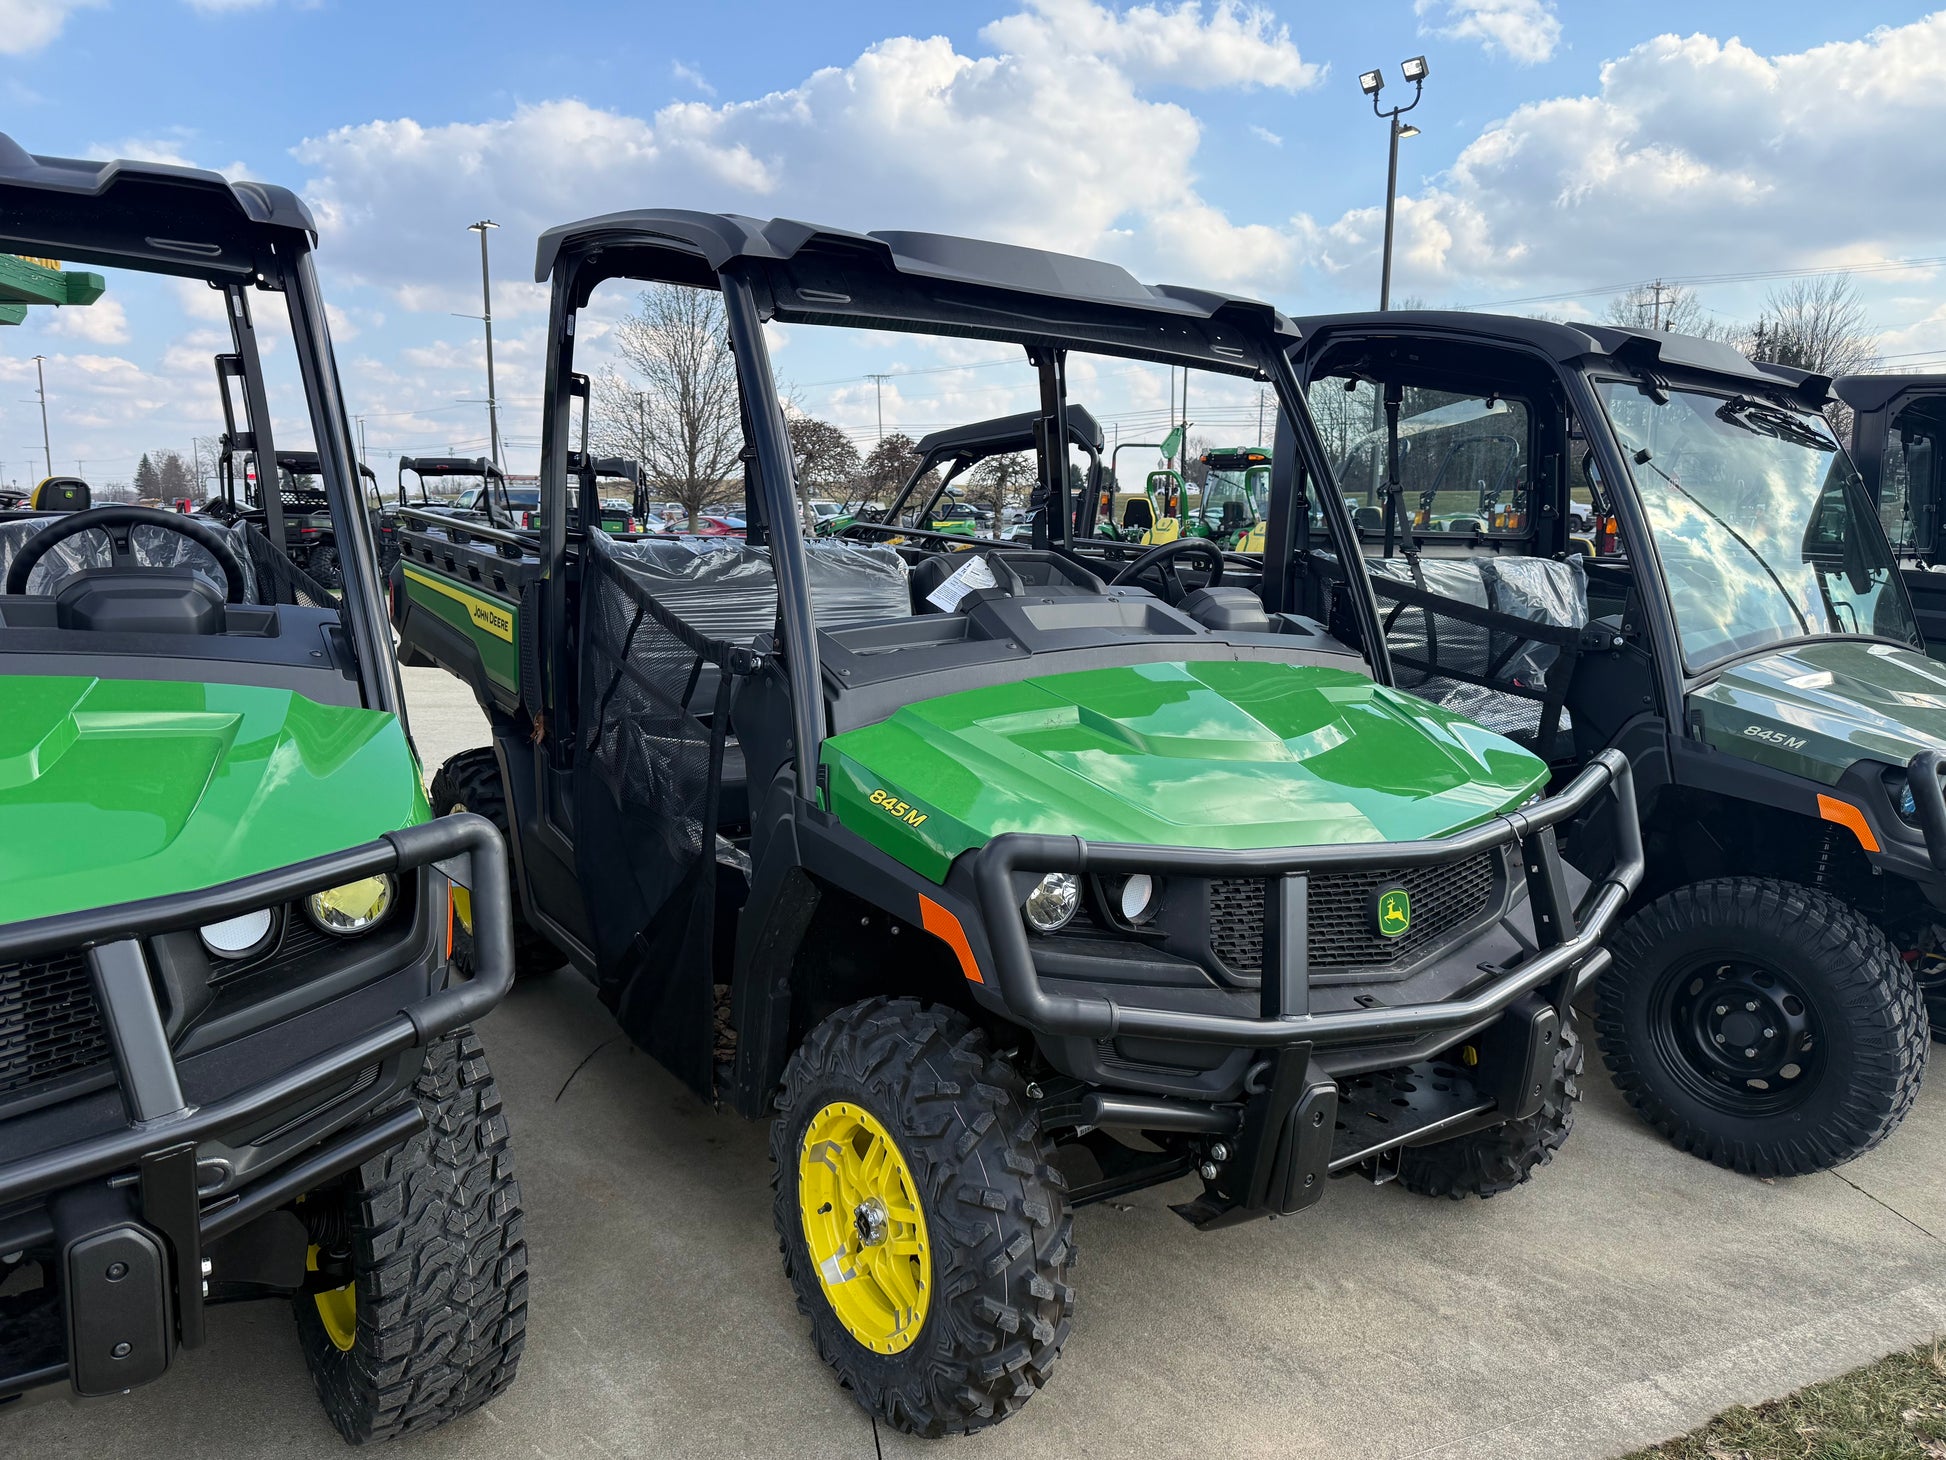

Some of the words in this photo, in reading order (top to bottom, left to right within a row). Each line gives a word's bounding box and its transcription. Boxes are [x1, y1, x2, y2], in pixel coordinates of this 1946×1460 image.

[474, 604, 489, 623] JOHN
[489, 611, 509, 632] DEERE
[1743, 725, 1808, 749] 845M
[869, 788, 929, 828] 845M
